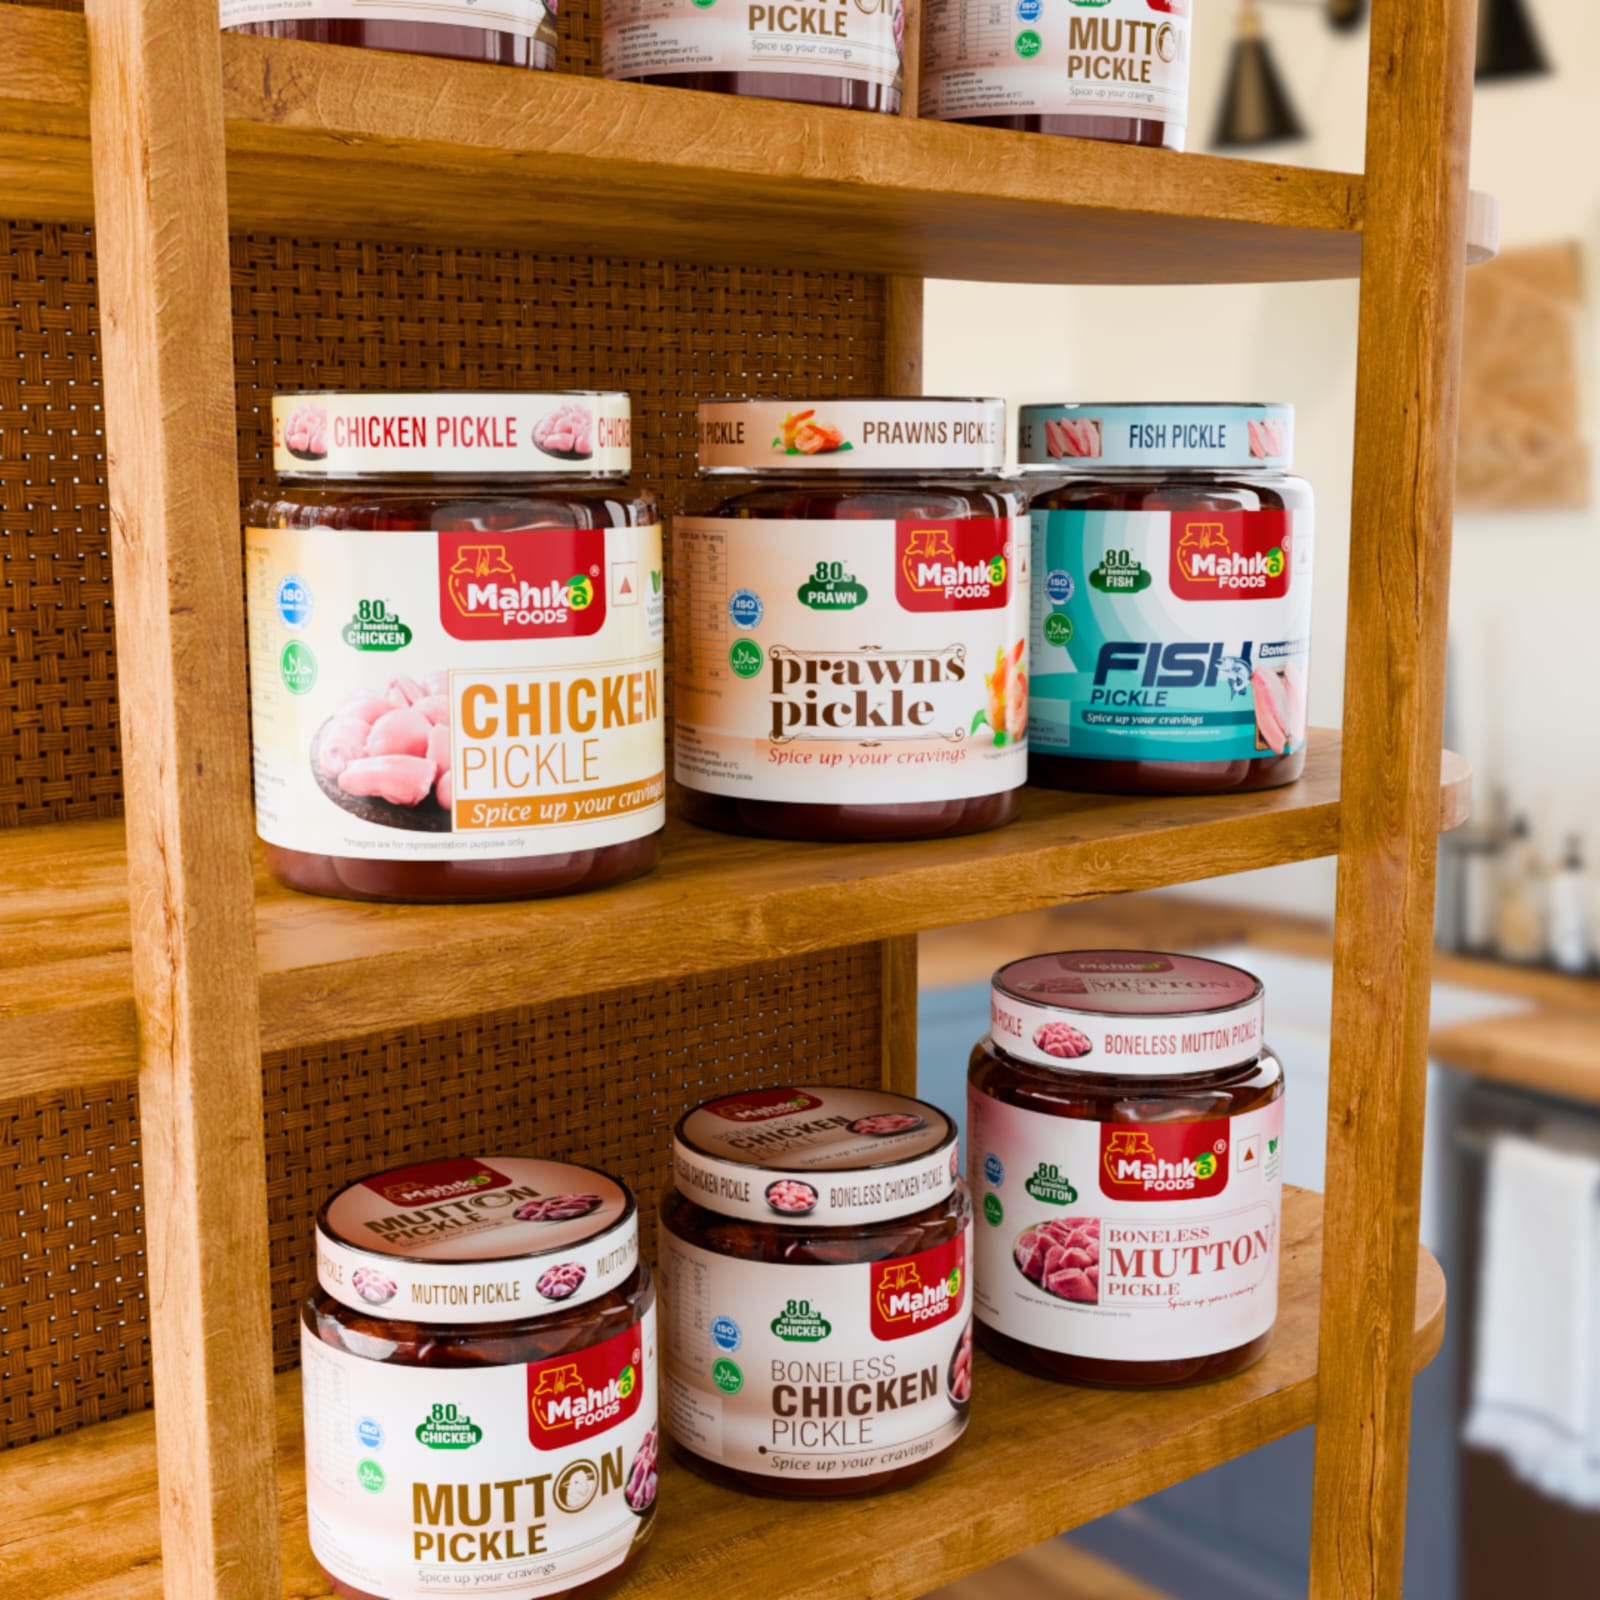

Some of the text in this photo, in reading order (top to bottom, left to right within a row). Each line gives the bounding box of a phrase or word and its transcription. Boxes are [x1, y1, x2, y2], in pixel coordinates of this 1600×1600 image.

[748, 5, 848, 37] PICKLE
[751, 39, 778, 51] Spice
[780, 41, 793, 54] up
[795, 43, 817, 54] your
[1069, 17, 1176, 63] MUTTO
[1067, 55, 1152, 83] PICKLE
[1070, 86, 1092, 97] Spice
[1095, 87, 1106, 100] up
[1109, 88, 1127, 99] your
[334, 416, 518, 448] CHICKEN PICKLE
[598, 417, 630, 448] CHICKE
[706, 421, 745, 445] PICKLE
[863, 421, 948, 444] PRAWNS
[953, 421, 996, 444] PICKLE
[1129, 424, 1226, 448] FISH PICKLE
[917, 559, 1003, 587] Mahika
[1192, 552, 1281, 577] Mahika
[467, 574, 588, 611] Mahika
[944, 585, 990, 600] FOODS
[1050, 578, 1067, 587] ISO
[1106, 576, 1134, 588] FISH
[1218, 575, 1266, 588] FOODS
[283, 589, 304, 602] ISO
[736, 600, 755, 609] ISO
[808, 591, 857, 604] PRAWN
[503, 609, 568, 626] FOODS
[348, 631, 405, 645] CHICKEN
[769, 656, 966, 694] prawns
[1093, 641, 1253, 688] FISH
[461, 668, 657, 740] CHICKEN
[1090, 689, 1169, 708] PICKLE
[769, 689, 934, 739] pickle
[1086, 712, 1204, 726] Spice up your cravings
[463, 739, 600, 790] PICKLE
[768, 747, 813, 767] Spice
[819, 749, 843, 768] up
[848, 750, 892, 768] your
[897, 747, 967, 767] cravings
[470, 803, 532, 827] Spice
[540, 802, 568, 822] up
[573, 798, 616, 820] your
[1105, 1018, 1257, 1056] BONELESS MUTTON PICKLE
[729, 1115, 851, 1150] CHICKEN
[1118, 1157, 1212, 1180] Mahika
[721, 1177, 750, 1202] PICKLE
[830, 1165, 943, 1208] BONELESS CHICKEN PICKLE
[1029, 1185, 1072, 1202] MUTTON
[1143, 1178, 1195, 1191] FOODS
[364, 1186, 541, 1234] MUTTON
[382, 1211, 489, 1244] PICKLE
[1109, 1227, 1210, 1243] BONELESS
[1106, 1224, 1270, 1278] MUTTON
[411, 1280, 521, 1305] MUTTON PICKLE
[890, 1277, 959, 1317] Mahika
[1108, 1282, 1181, 1297] PICKLE
[912, 1298, 950, 1324] FOODS
[717, 1323, 734, 1335] ISO
[775, 1325, 826, 1337] CHICKEN
[771, 1354, 896, 1383] BONELESS
[547, 1375, 632, 1425] Mahika
[772, 1364, 938, 1418] CHICKEN
[575, 1400, 621, 1431] FOODS
[420, 1431, 477, 1444] CHICKEN
[772, 1417, 875, 1448] PICKLE
[770, 1439, 935, 1472] Spice up your cravings
[412, 1445, 624, 1527] MUTTON
[413, 1523, 548, 1563] PICKLE
[418, 1561, 557, 1585] Spice up your cravings
